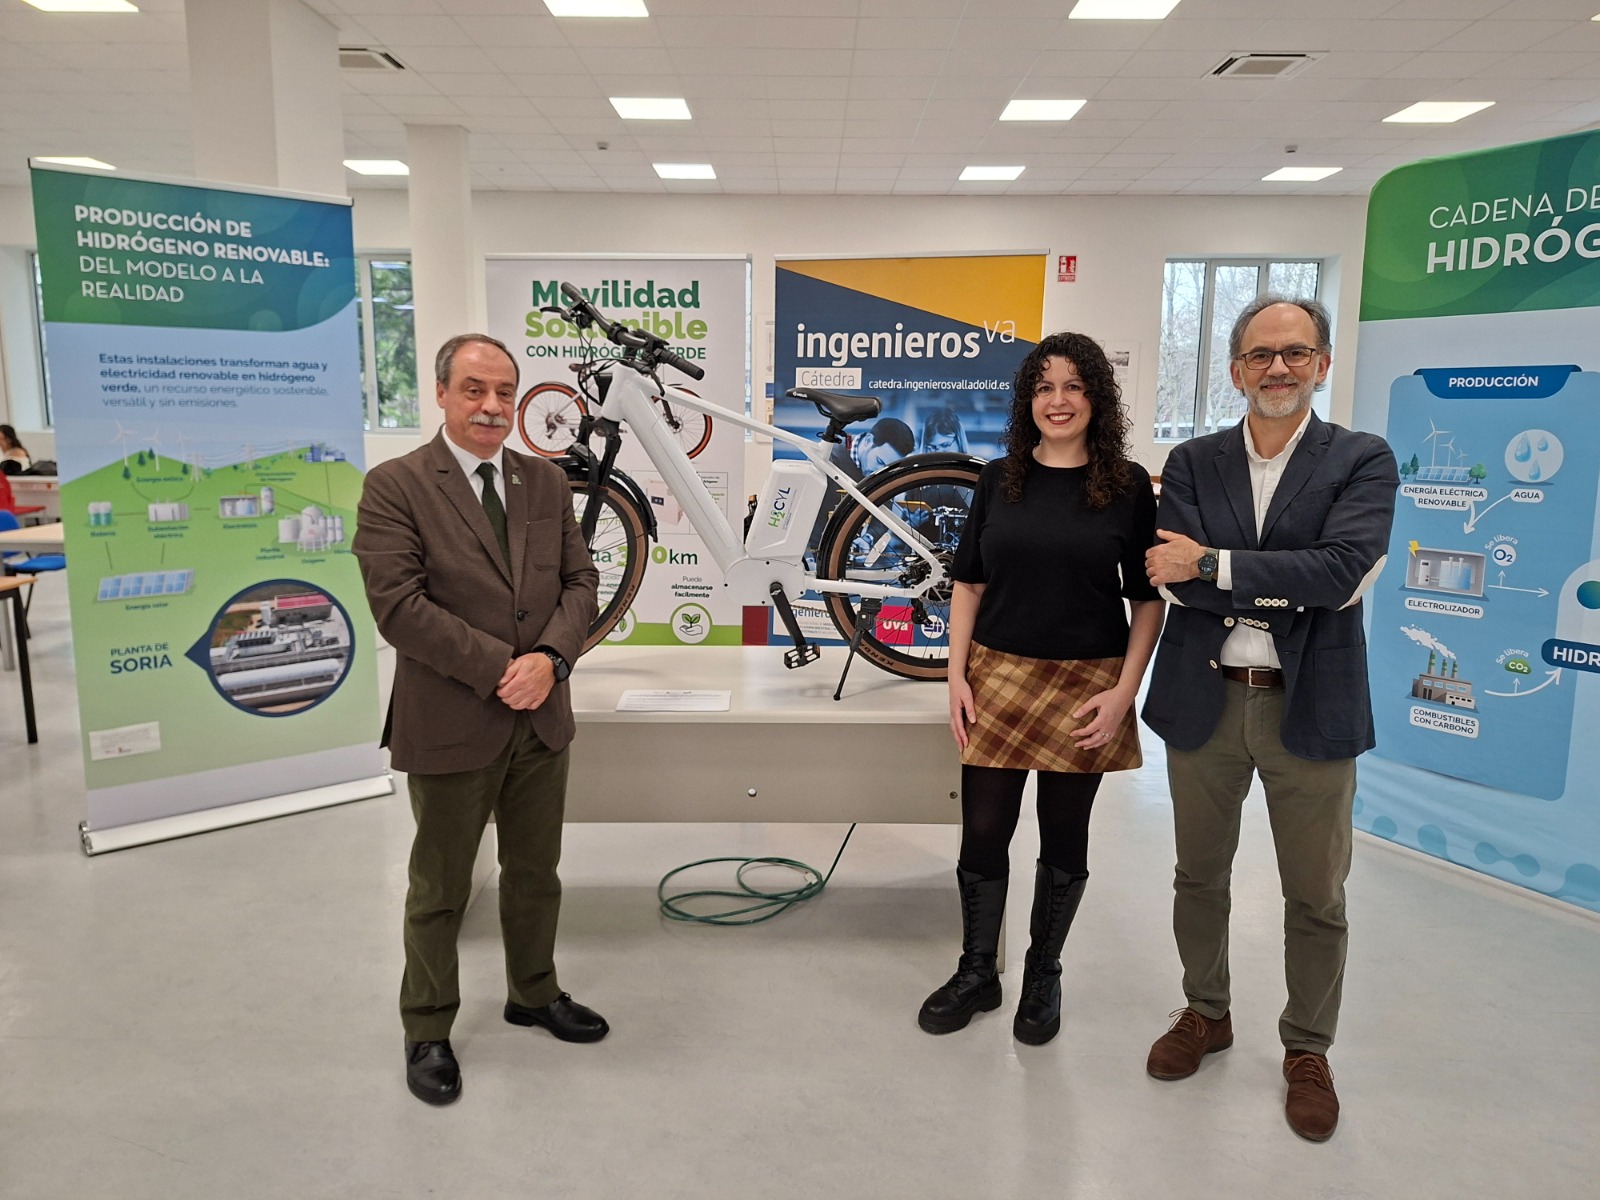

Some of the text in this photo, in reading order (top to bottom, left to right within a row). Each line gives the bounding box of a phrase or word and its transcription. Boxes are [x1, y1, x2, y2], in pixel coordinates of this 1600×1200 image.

[1429, 184, 1600, 230] CADENA DE
[75, 204, 252, 238] PRODUCCIÓN DE
[77, 230, 330, 267] HIDRÓGENO RENOVABLE:
[79, 255, 264, 285] DEL MODELO A LA
[82, 280, 184, 303] REALIDAD
[526, 345, 558, 358] CON
[797, 322, 981, 367] ingenieros
[99, 354, 328, 372] Estas instalaciones transforman agua y
[100, 368, 316, 385] electricidad renovable en hidrógeno
[801, 370, 855, 386] Cátedra
[868, 378, 1010, 391] catedra.ingenierosvalladolid.es
[1448, 373, 1539, 388] PRODUCCIÓN
[143, 385, 159, 394] un
[162, 384, 207, 394] recurso
[209, 385, 270, 397] energético
[102, 397, 147, 408] versátil
[148, 399, 155, 409] y
[158, 398, 175, 408] sin
[1403, 486, 1484, 498] ENERGÍA ELÉCTRICA
[1514, 491, 1540, 499] AGUA
[1418, 498, 1467, 508] RENOVABLE
[1485, 535, 1518, 550] Se libera
[671, 583, 713, 591] almacenarse
[1408, 600, 1481, 616] ELECTROLIZADOR
[110, 643, 169, 657] PLANTA DE
[1495, 648, 1530, 665] Se libera
[110, 654, 173, 675] SORIA
[1413, 708, 1476, 727] COMBUSTIBLES
[1413, 716, 1474, 734] CON CARBONO
